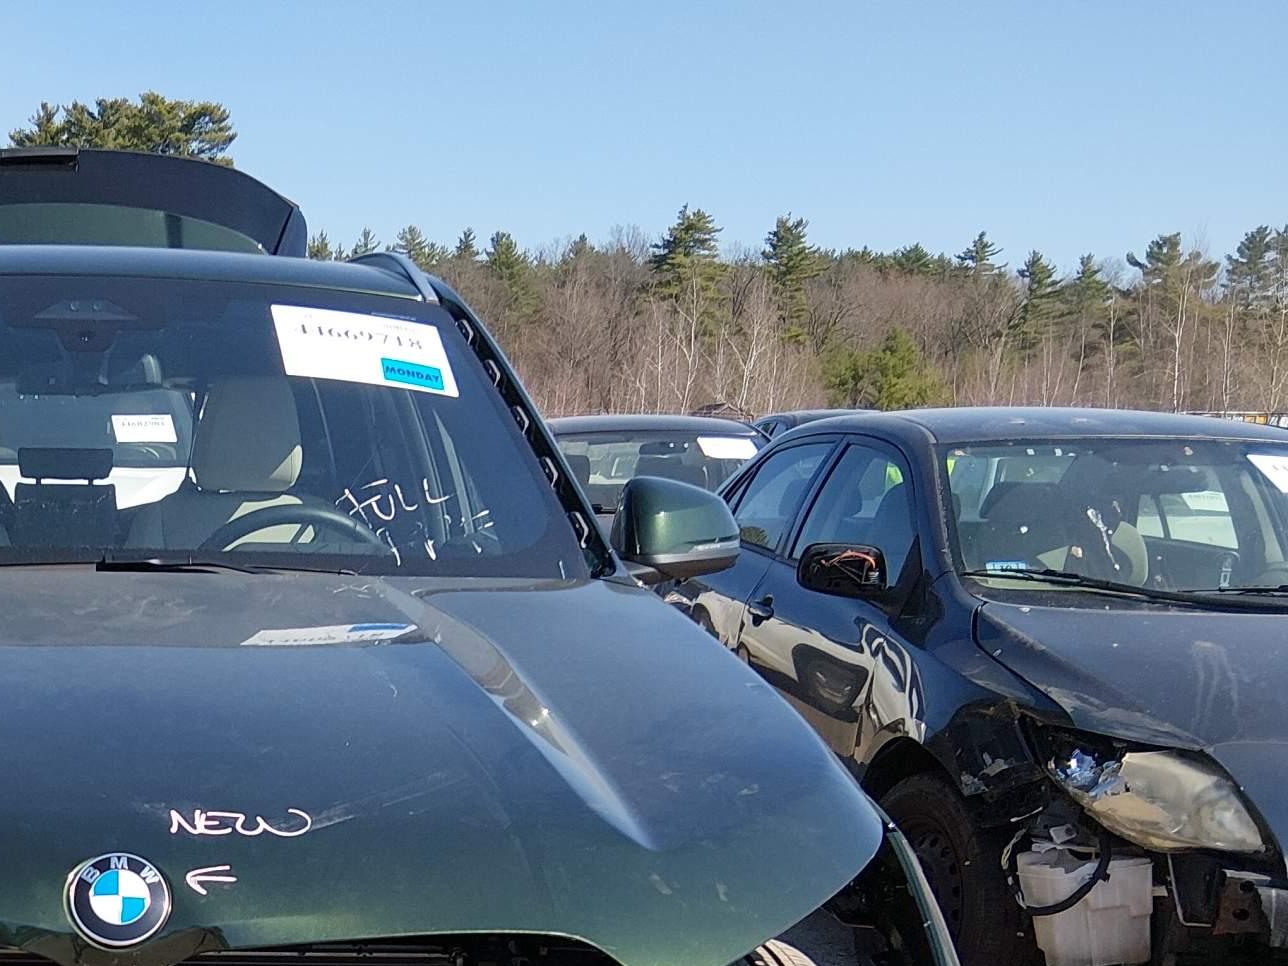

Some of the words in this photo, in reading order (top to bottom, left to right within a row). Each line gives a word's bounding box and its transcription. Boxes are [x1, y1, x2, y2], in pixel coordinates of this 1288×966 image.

[384, 365, 440, 383] MONDAY
[169, 808, 312, 838] NEW
[80, 855, 161, 884] BMW
